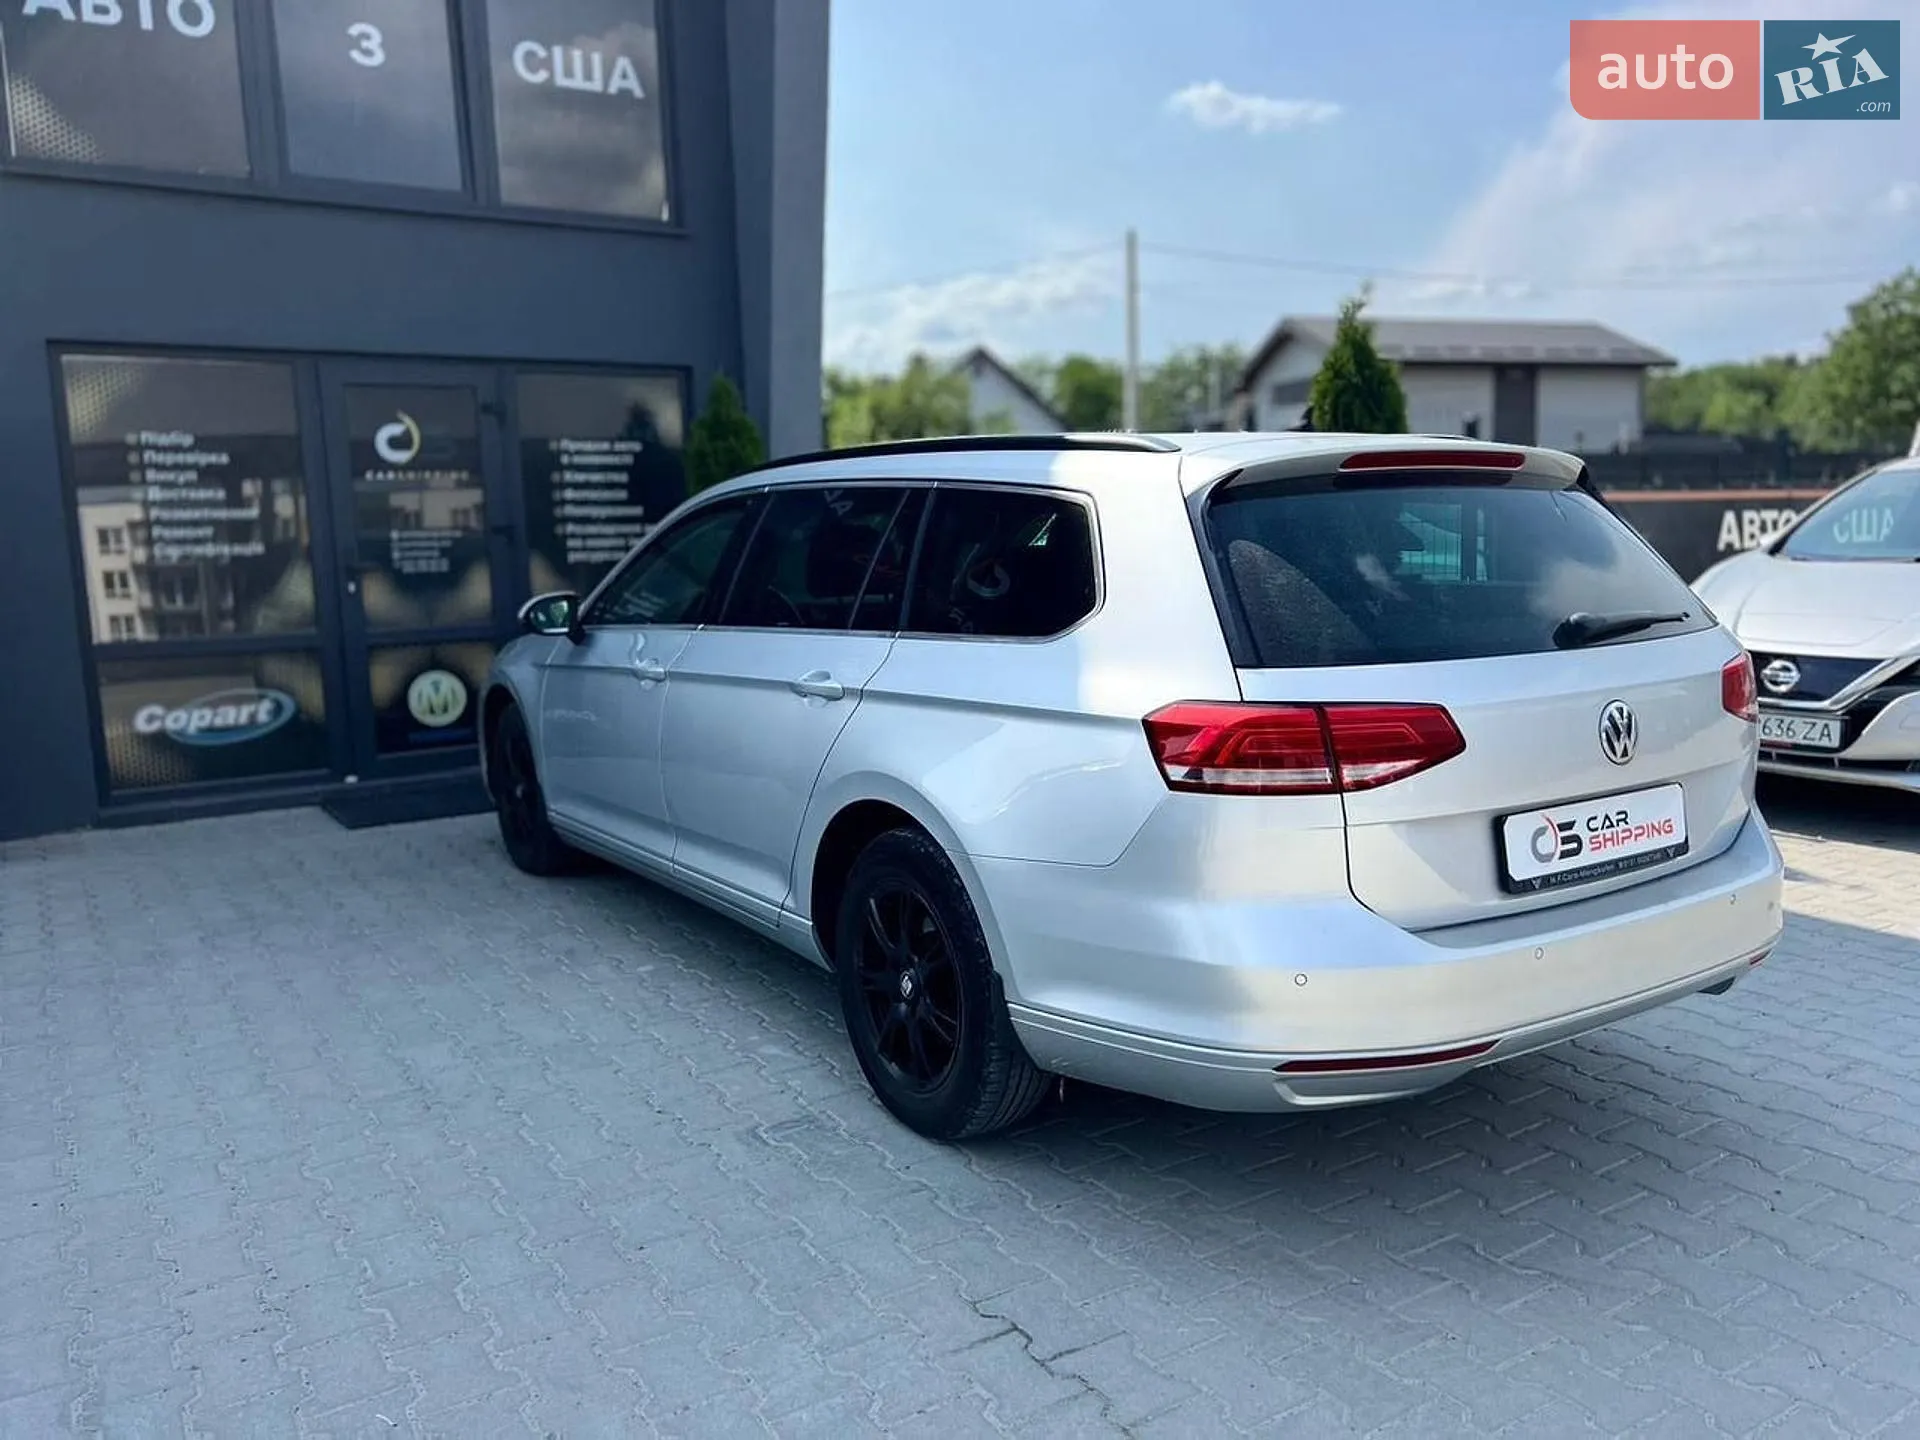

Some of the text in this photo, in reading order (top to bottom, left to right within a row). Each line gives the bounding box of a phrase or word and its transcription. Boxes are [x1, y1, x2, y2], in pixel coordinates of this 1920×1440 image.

[512, 40, 645, 99] США
[133, 699, 276, 734] Copart
[1761, 717, 1833, 744] 636 ZA
[1586, 809, 1631, 833] CAR
[1588, 818, 1674, 853] SHIPPING
